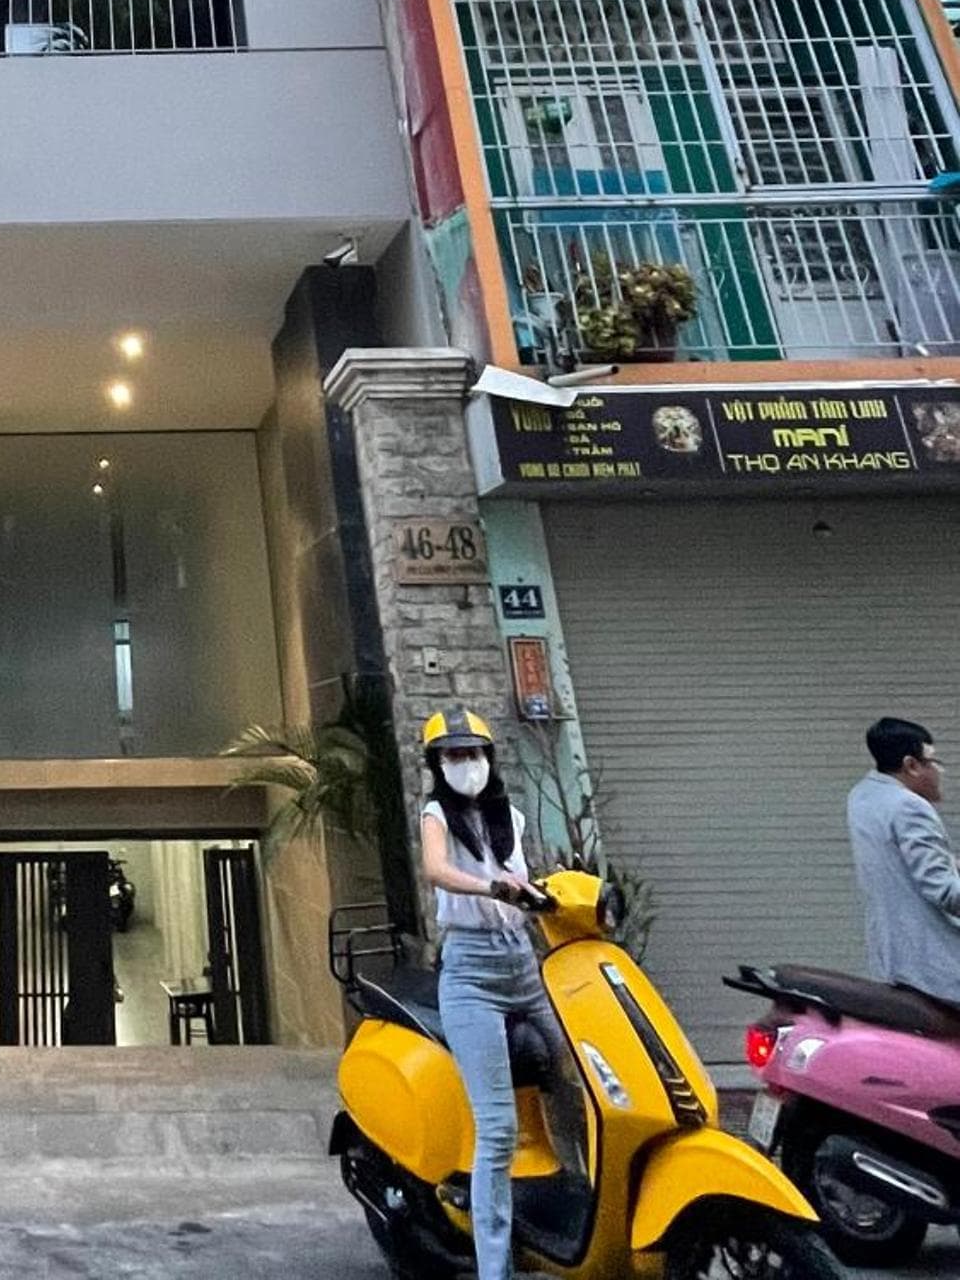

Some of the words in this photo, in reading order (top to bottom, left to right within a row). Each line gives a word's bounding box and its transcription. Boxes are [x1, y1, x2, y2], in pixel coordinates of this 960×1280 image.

[786, 453, 821, 470] AN
[824, 451, 911, 470] KHANG
[402, 526, 477, 560] 46-48
[504, 589, 539, 608] 44
